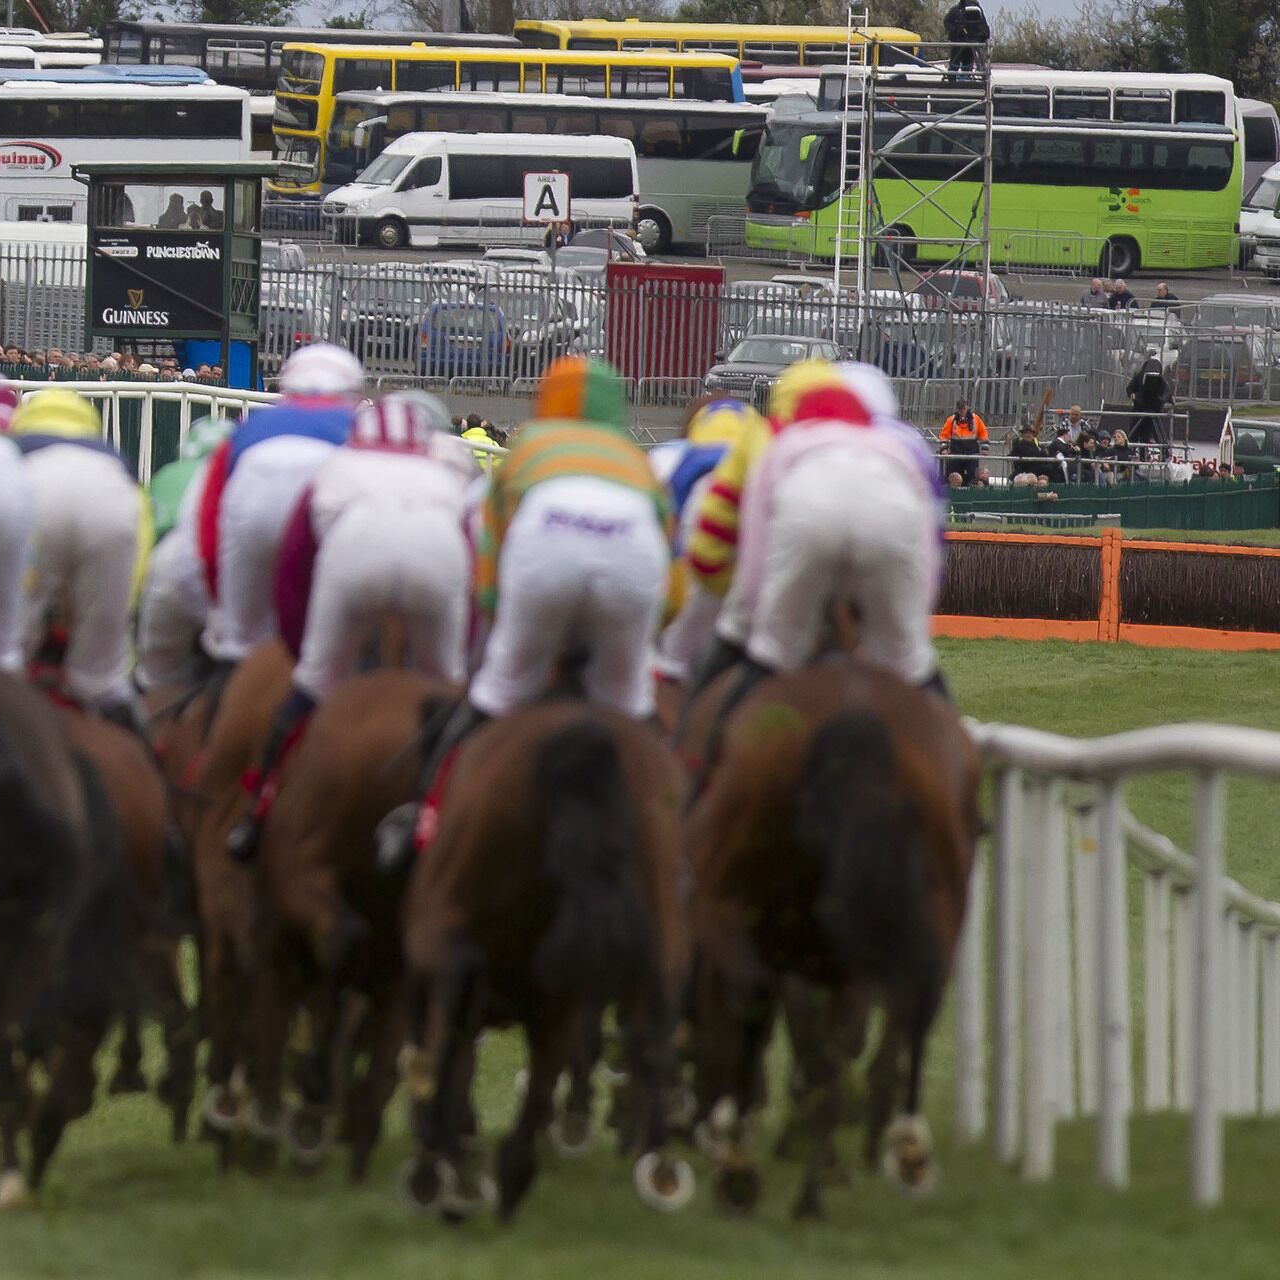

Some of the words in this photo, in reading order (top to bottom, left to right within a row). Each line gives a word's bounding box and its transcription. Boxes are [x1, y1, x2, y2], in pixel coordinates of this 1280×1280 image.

[534, 183, 560, 217] A
[146, 245, 220, 260] PUNCHESTOWN
[102, 307, 169, 326] GUINNESS
